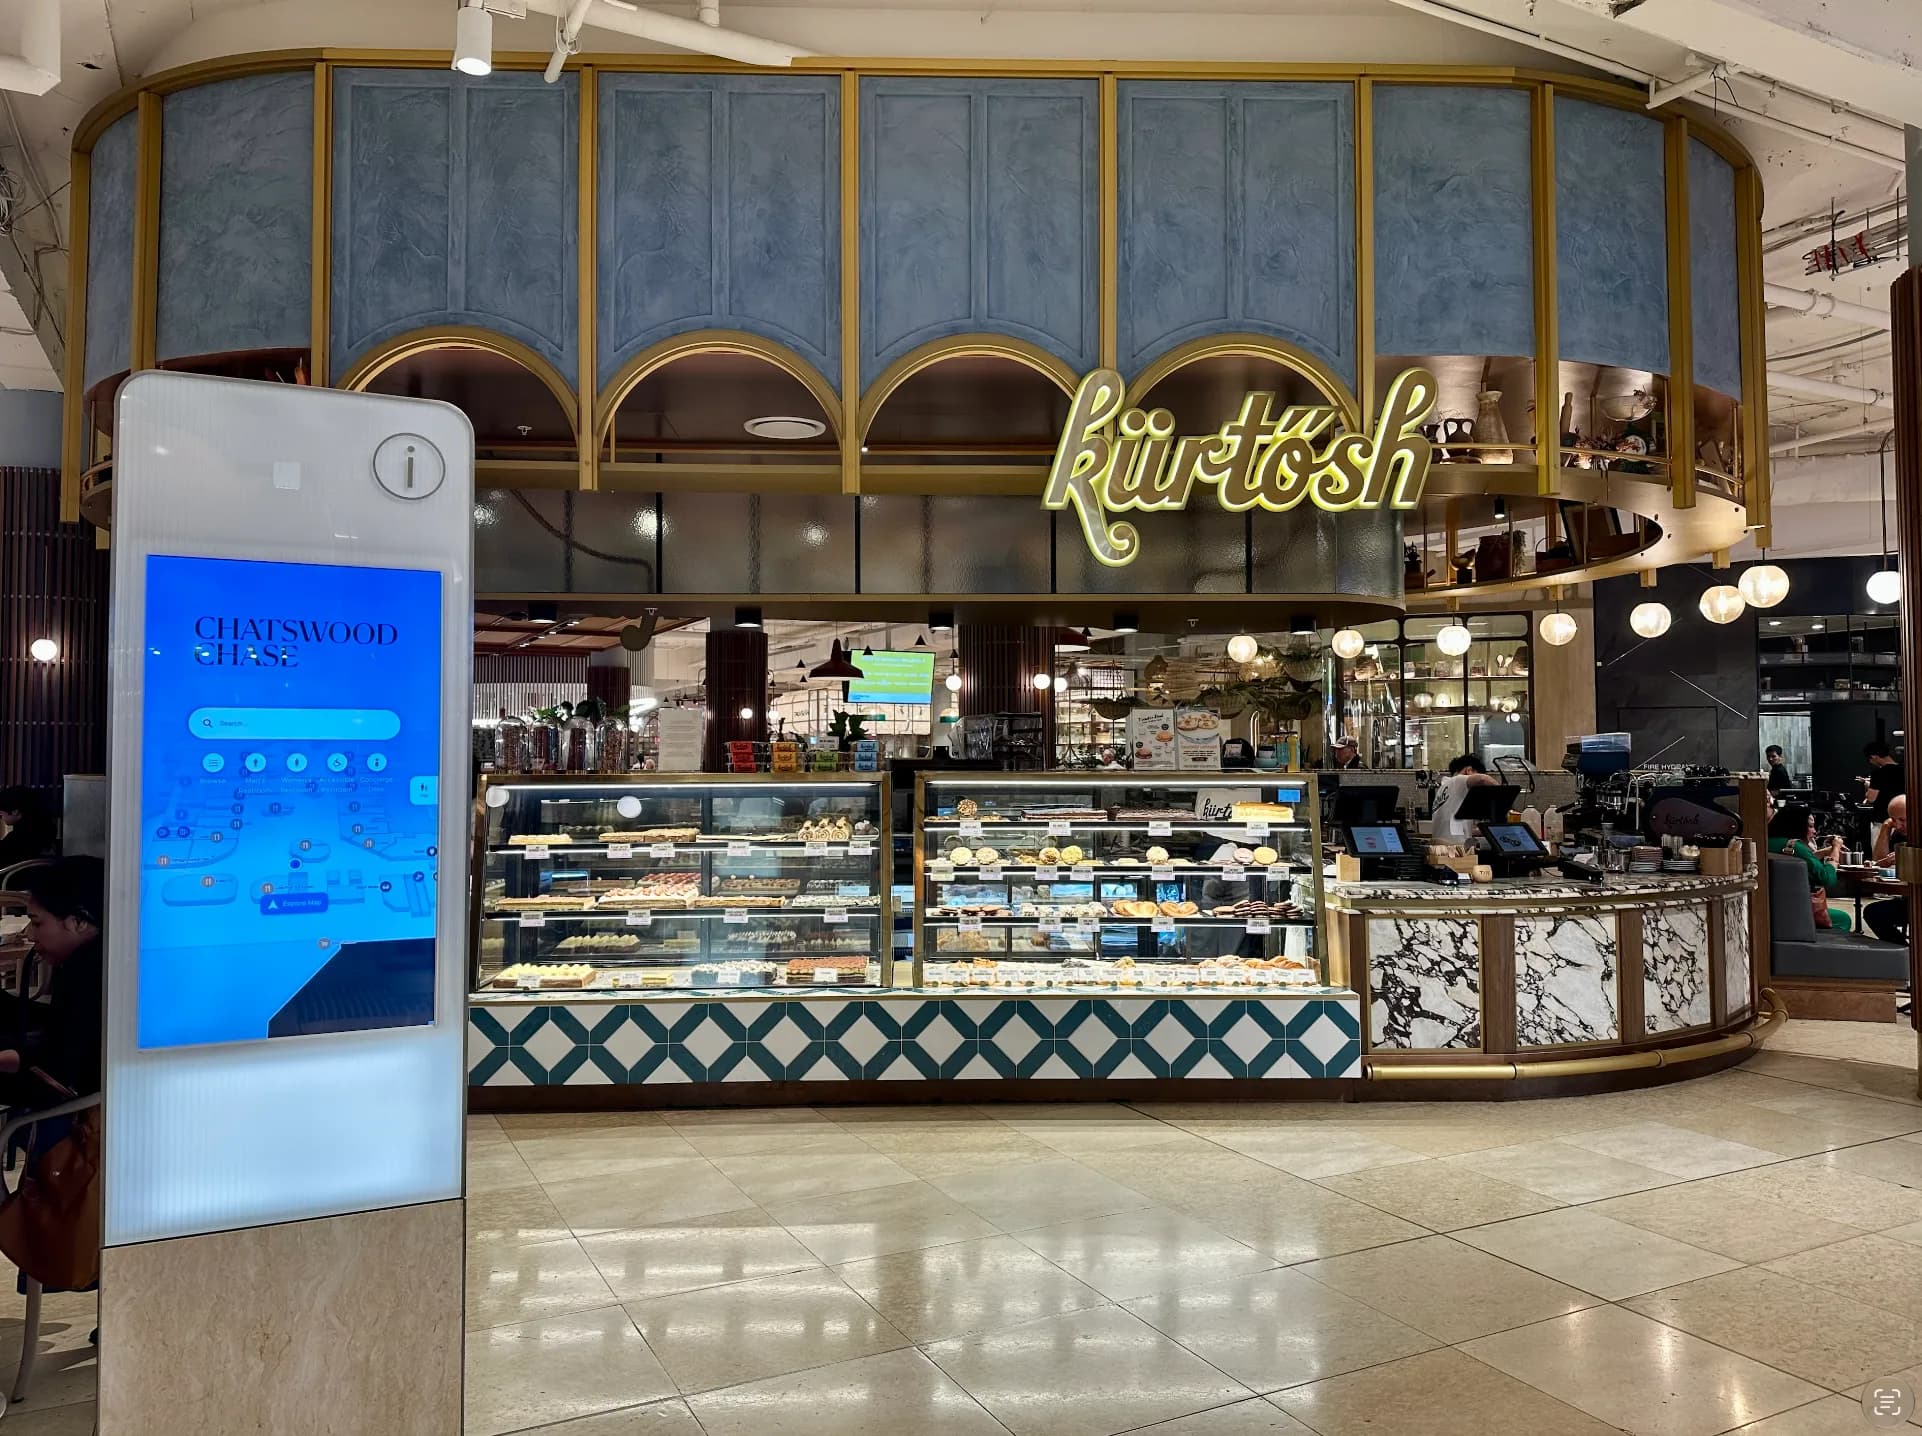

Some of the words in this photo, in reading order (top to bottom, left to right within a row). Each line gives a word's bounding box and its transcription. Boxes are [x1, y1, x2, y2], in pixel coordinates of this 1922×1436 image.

[194, 616, 398, 646] CHATSWOOD
[194, 642, 299, 668] CHASE
[1203, 798, 1233, 821] kürt
